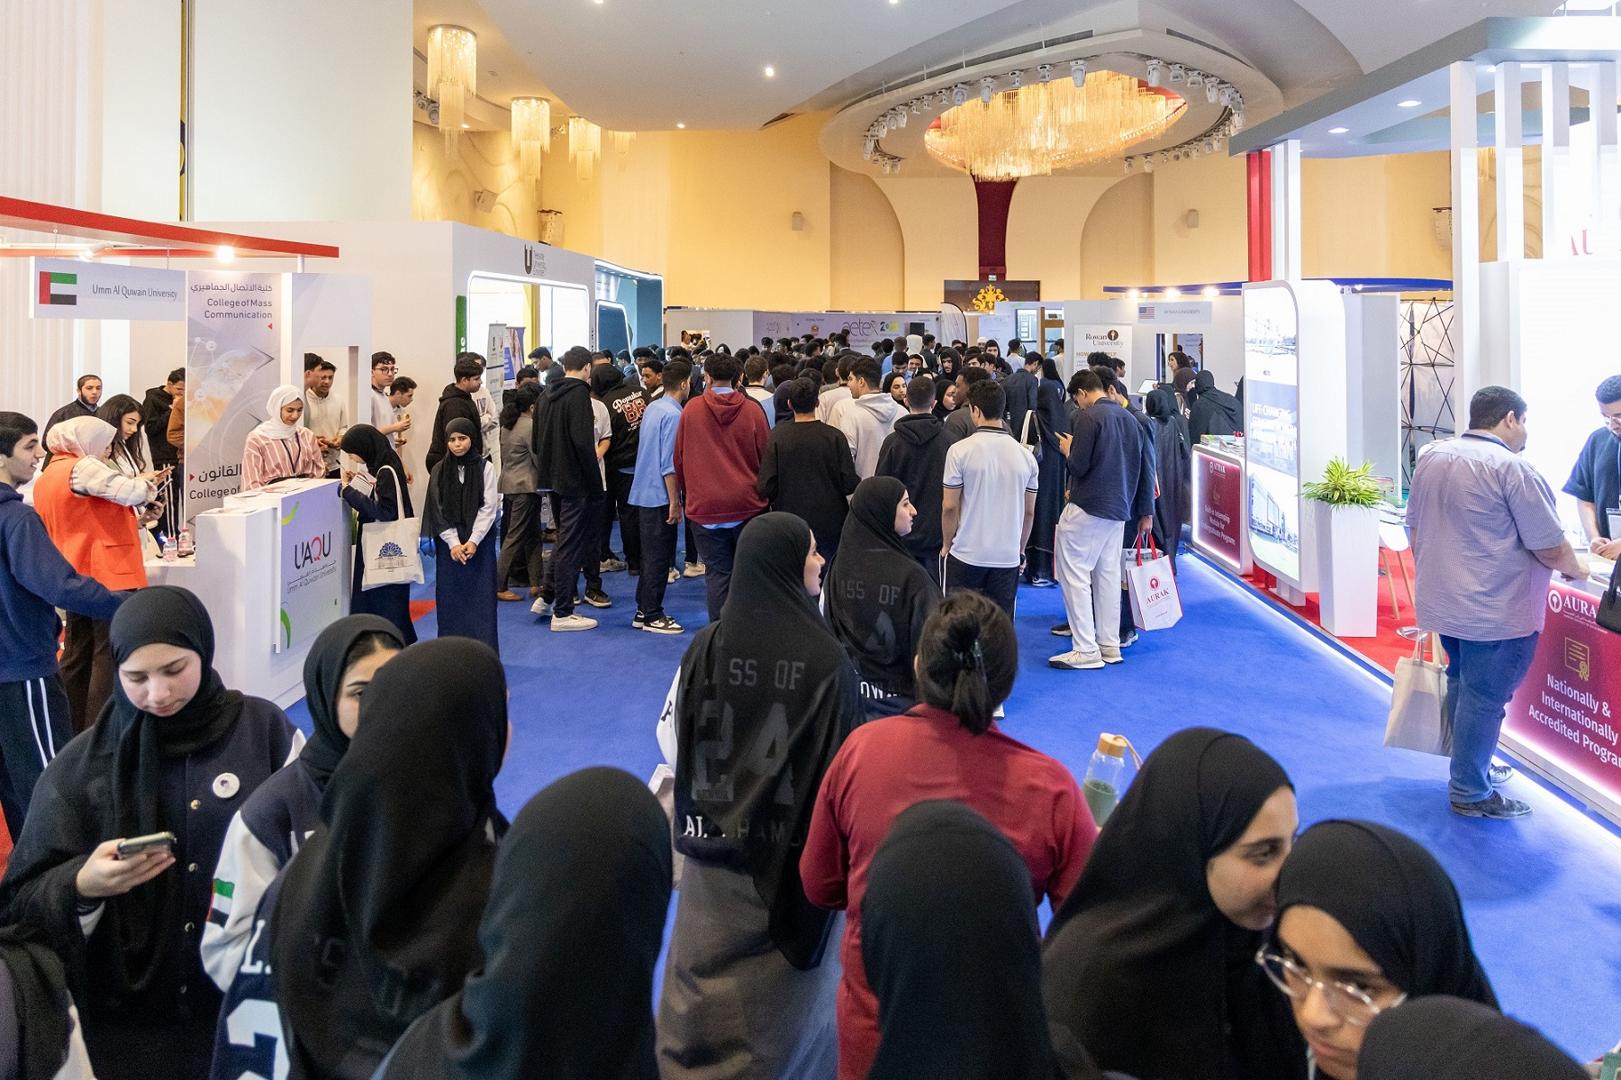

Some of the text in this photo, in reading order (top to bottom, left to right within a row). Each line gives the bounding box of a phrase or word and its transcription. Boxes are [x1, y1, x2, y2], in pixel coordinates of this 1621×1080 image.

[92, 284, 112, 295] Umm
[113, 285, 120, 296] Al
[148, 287, 178, 300] University
[190, 283, 230, 292] الجماهيري
[207, 298, 241, 308] College
[250, 299, 273, 307] Mass
[204, 310, 273, 319] Communication
[198, 463, 242, 482] القانون
[189, 488, 230, 500] College
[294, 531, 331, 570] UAQU
[1146, 587, 1170, 605] AURAK
[1563, 594, 1600, 619] AURA
[774, 659, 805, 690] OF
[1547, 673, 1612, 718] Nationally &
[1528, 704, 1580, 744] Accredited
[1541, 690, 1619, 746] Internationally
